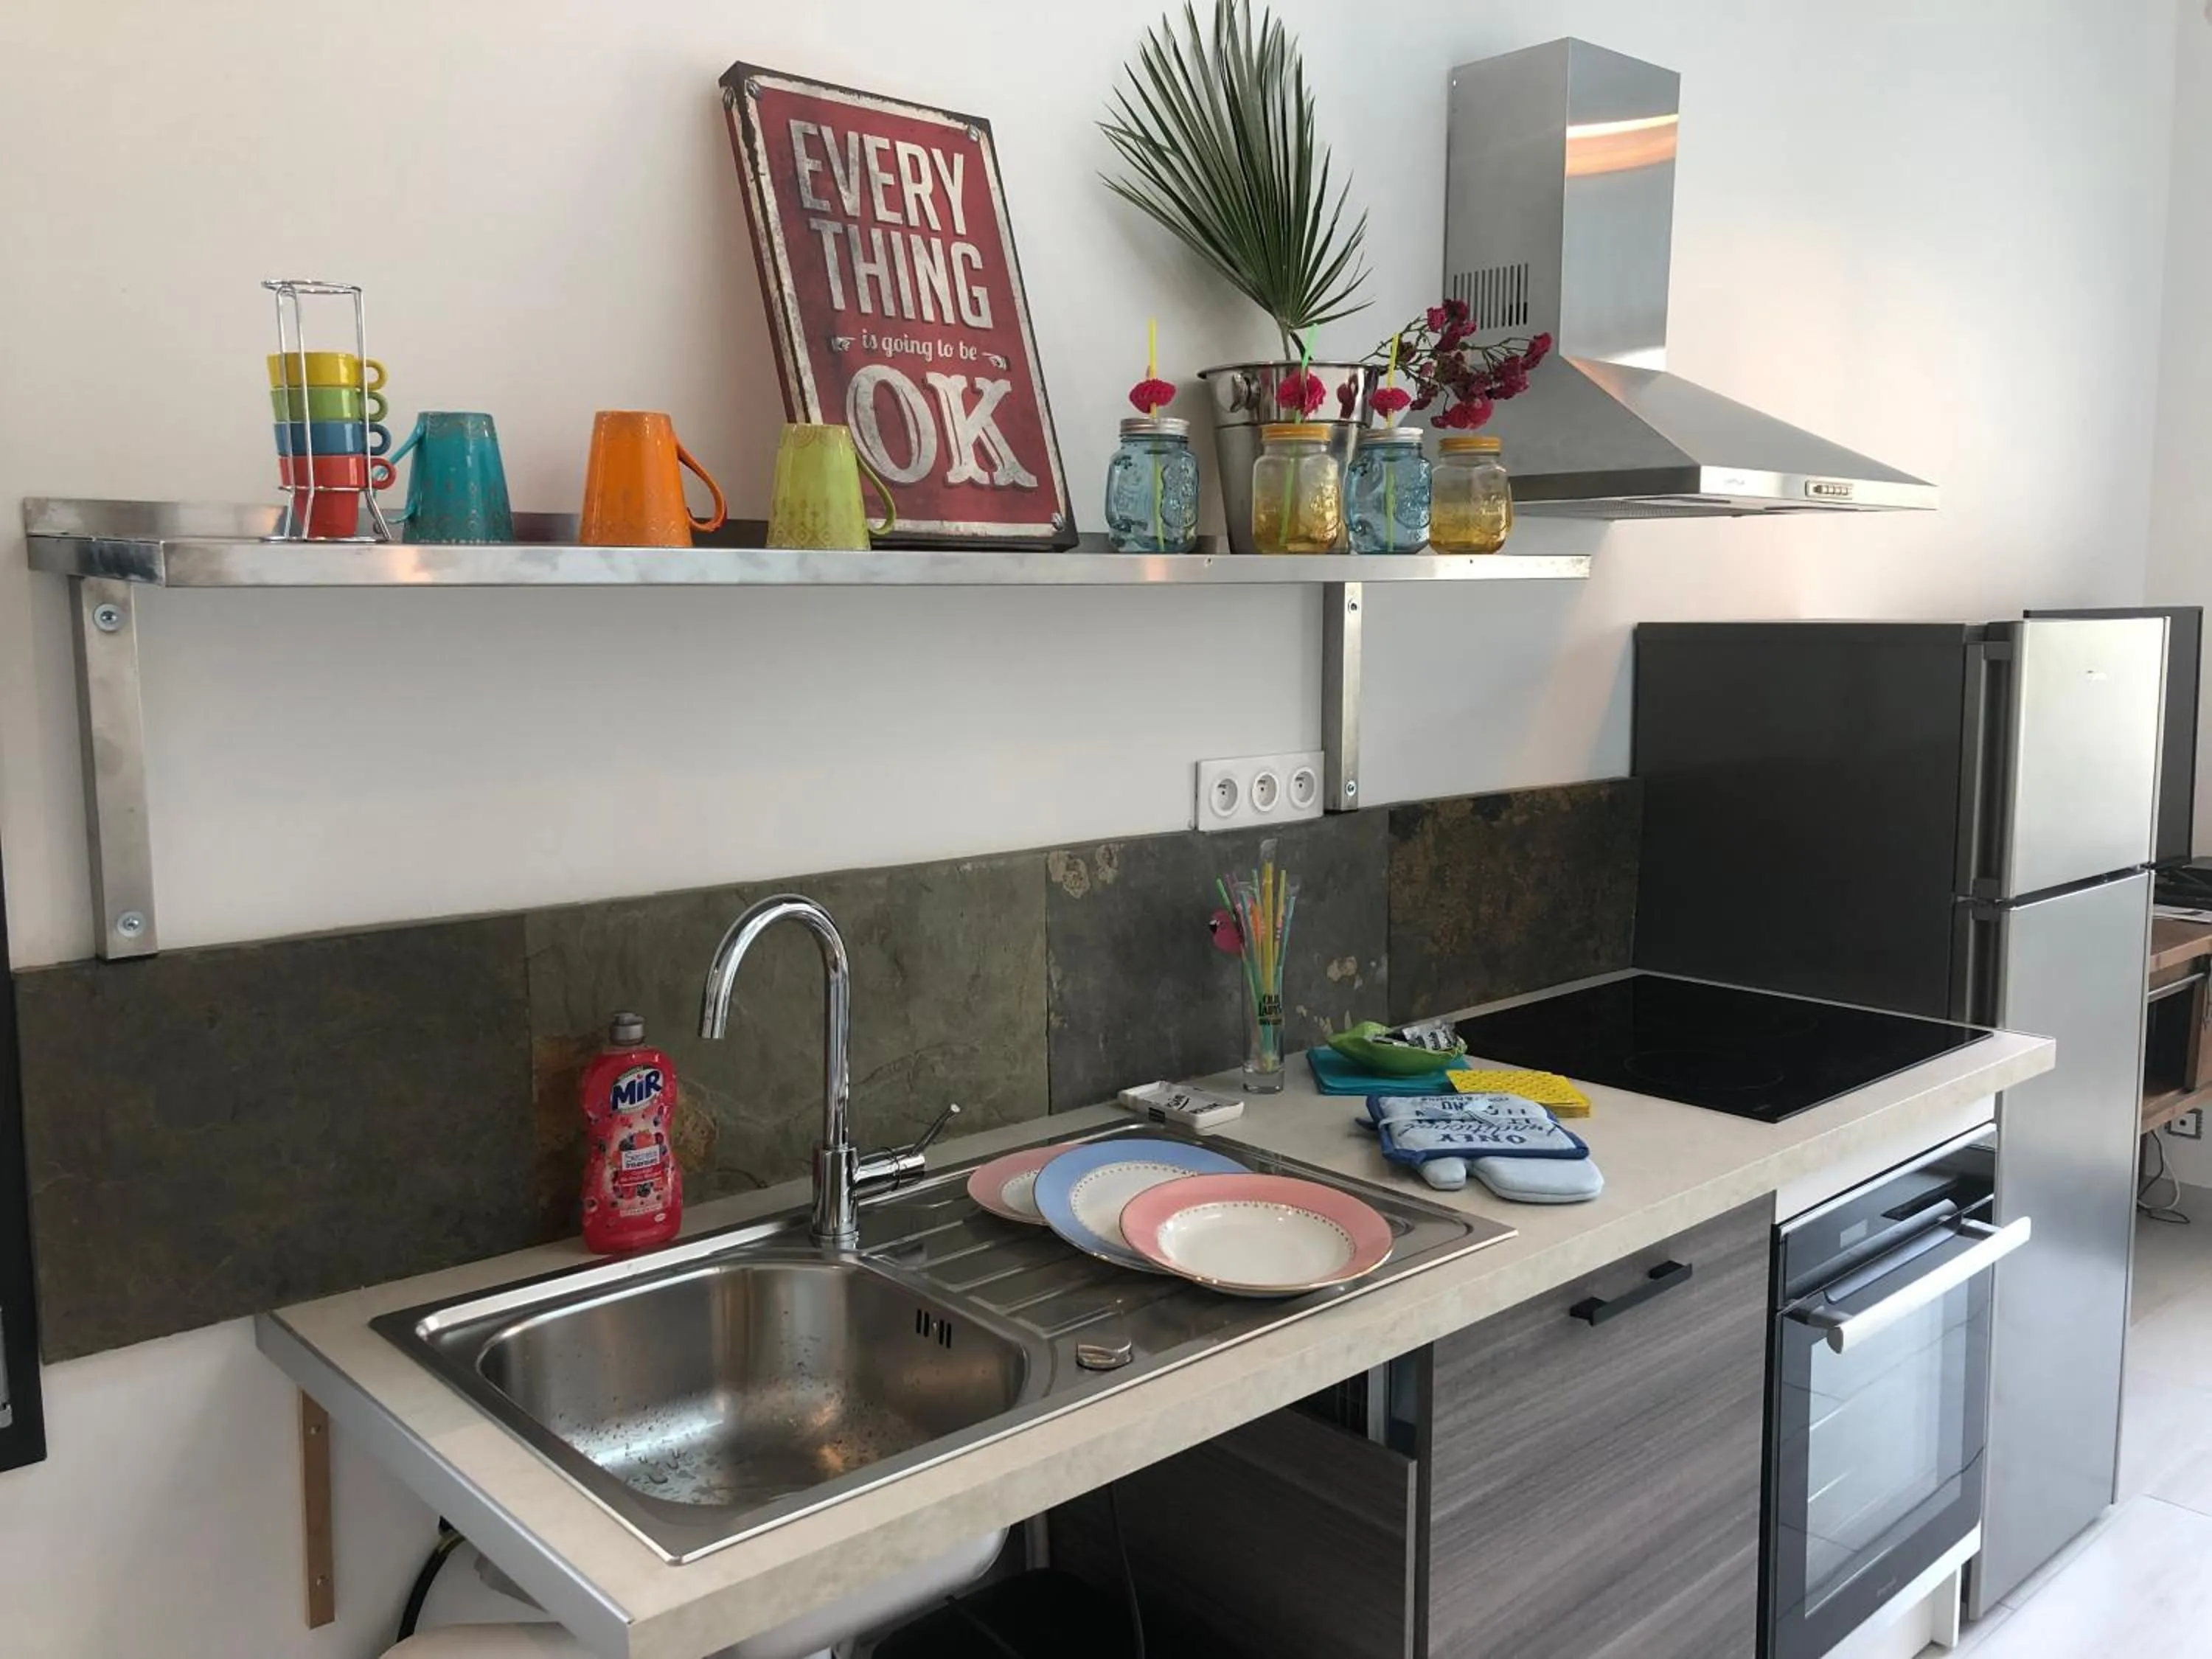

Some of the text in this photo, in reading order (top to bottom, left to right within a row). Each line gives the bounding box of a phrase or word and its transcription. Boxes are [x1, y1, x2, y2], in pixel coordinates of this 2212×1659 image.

[788, 119, 966, 234] EVERY
[809, 218, 993, 330] THING
[861, 328, 978, 362] is going to be
[845, 364, 1037, 487] OK
[1436, 1133, 1527, 1144] ONLY
